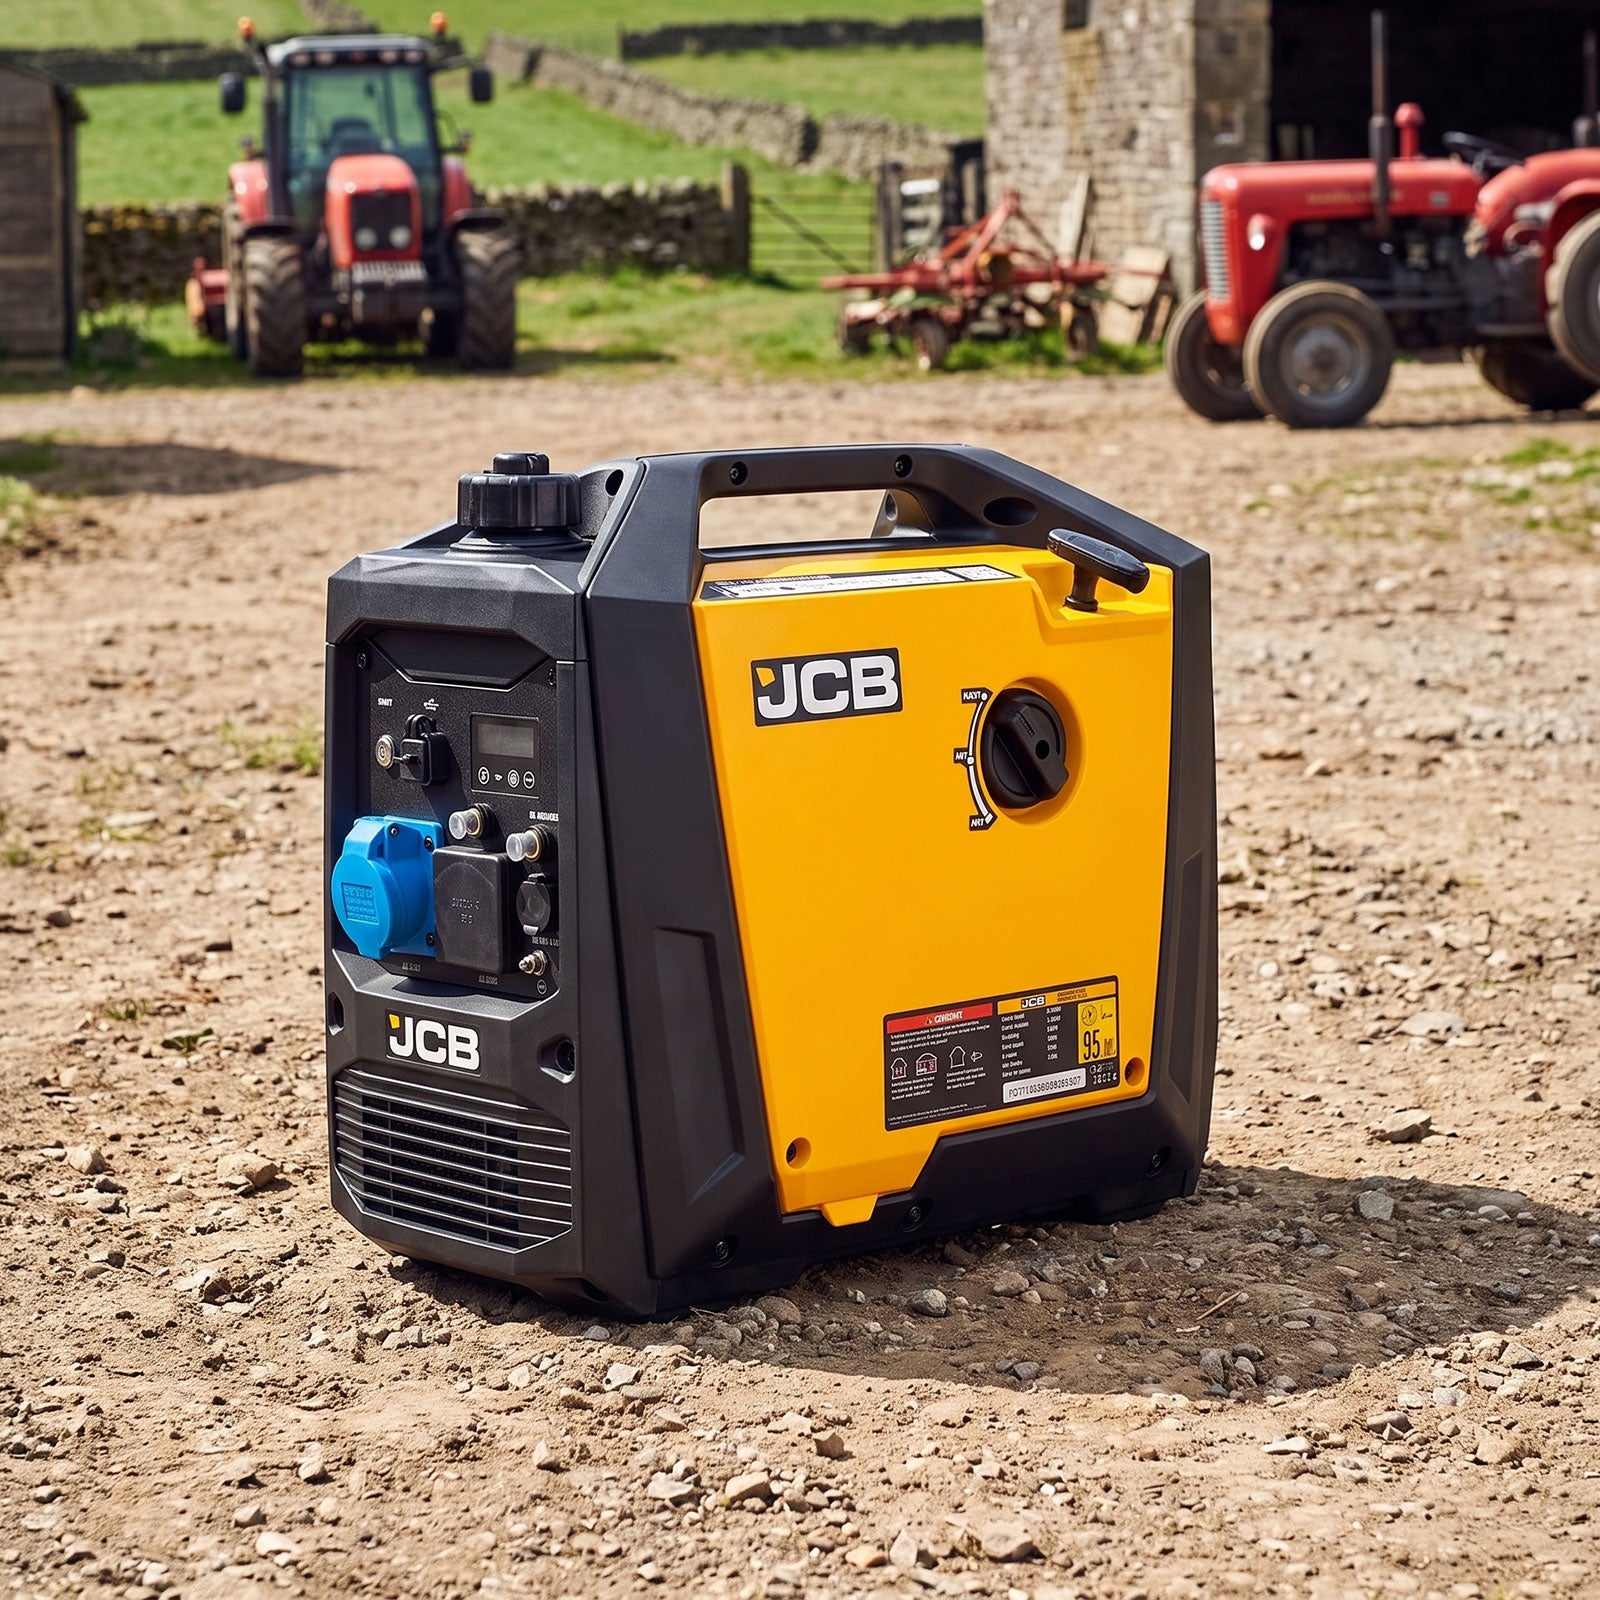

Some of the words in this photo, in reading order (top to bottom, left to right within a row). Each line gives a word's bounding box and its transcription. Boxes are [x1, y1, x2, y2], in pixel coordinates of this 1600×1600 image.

[756, 655, 899, 719] JCB
[1021, 996, 1045, 1008] JCB
[389, 1014, 480, 1071] JCB
[1083, 1029, 1101, 1061] 95
